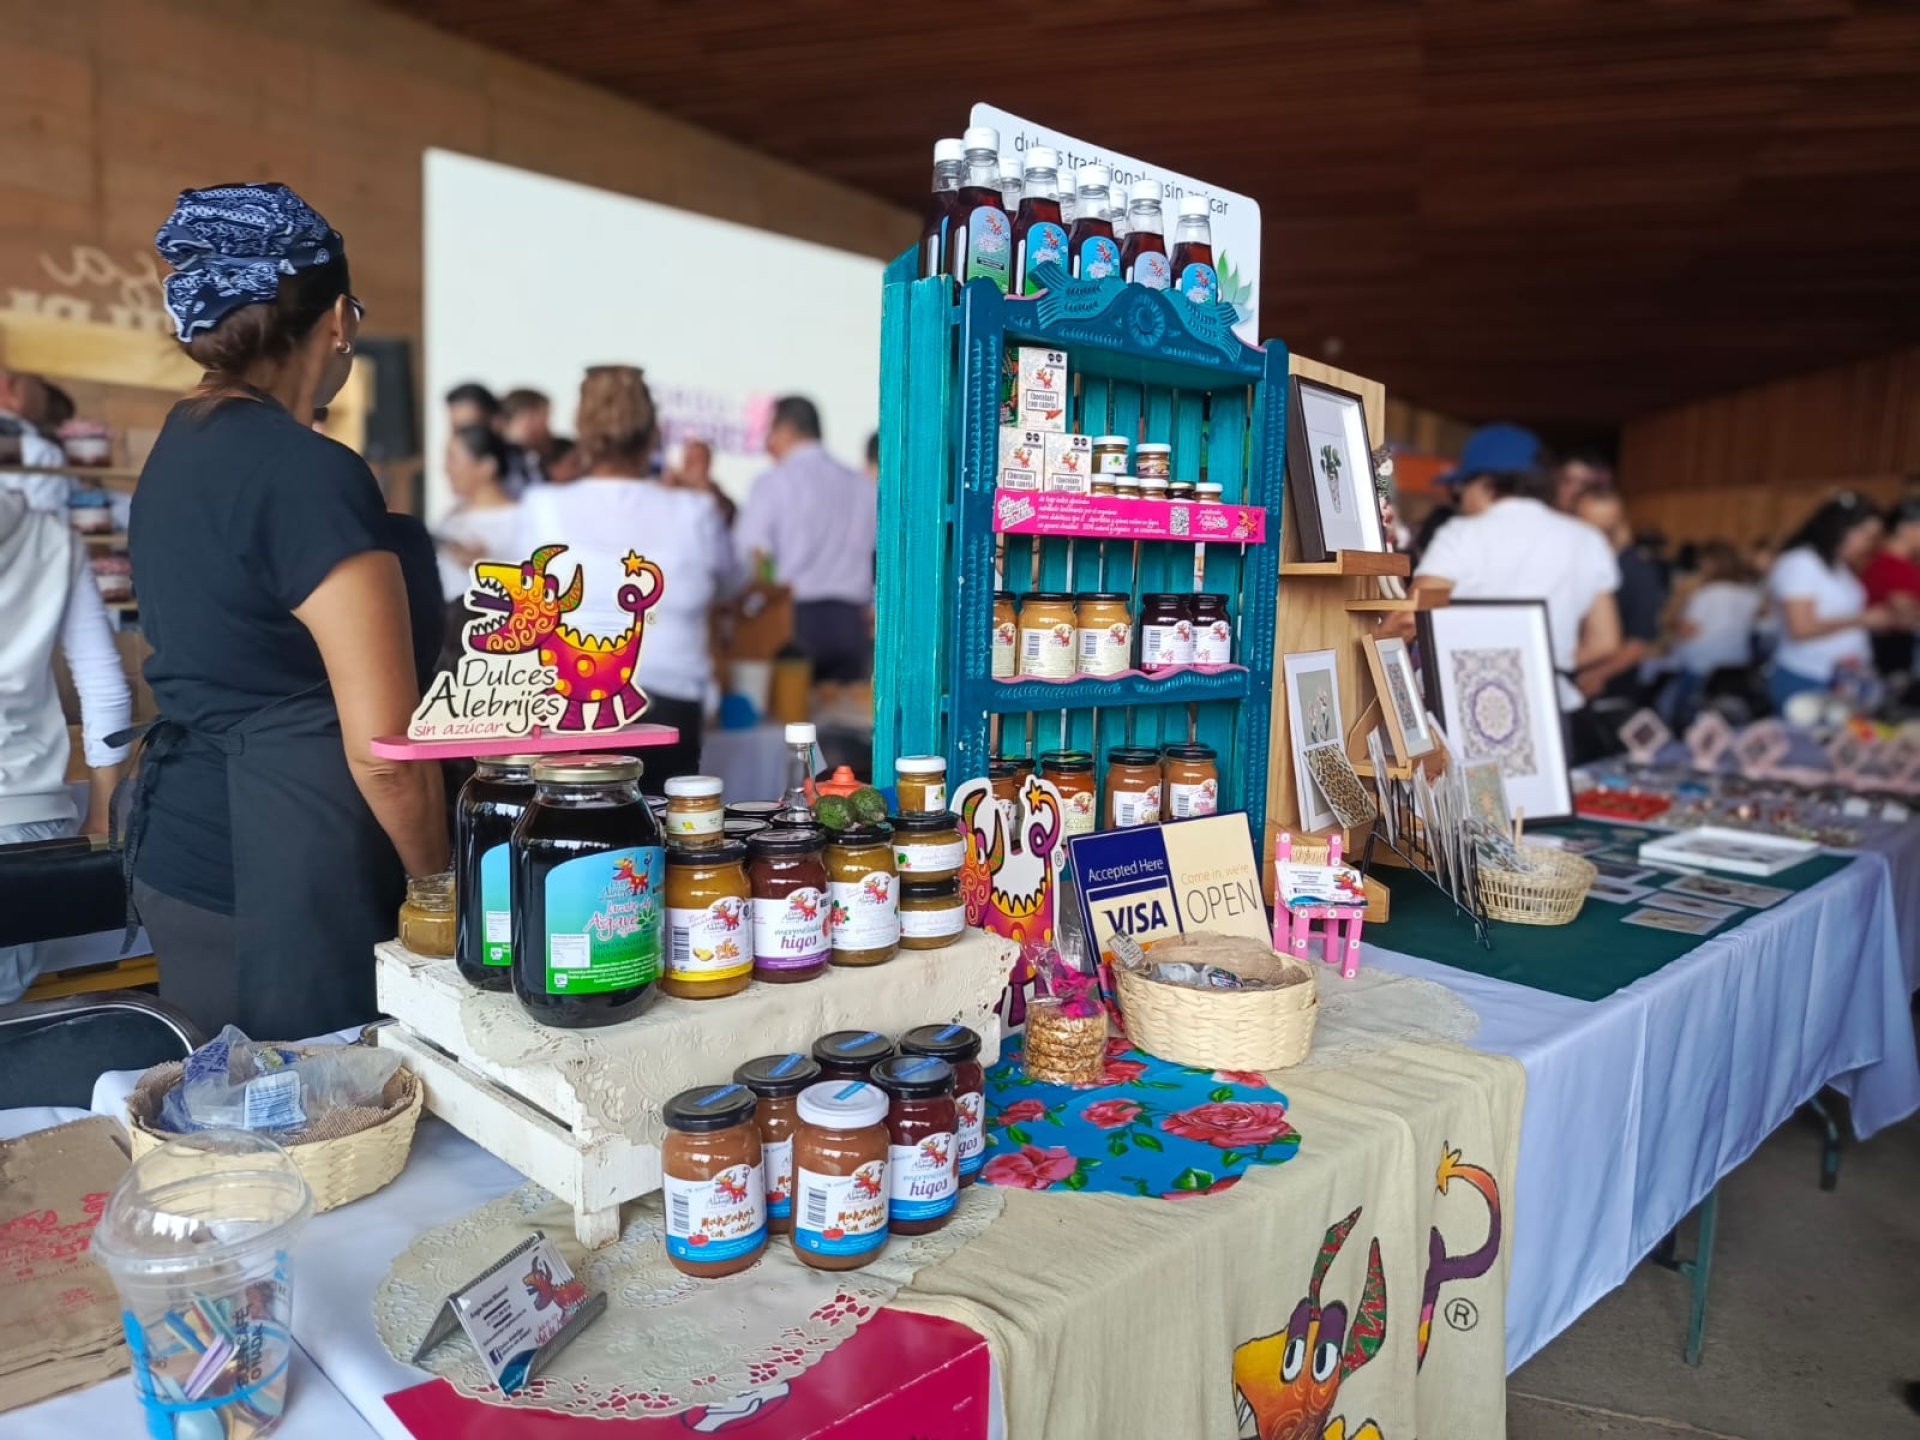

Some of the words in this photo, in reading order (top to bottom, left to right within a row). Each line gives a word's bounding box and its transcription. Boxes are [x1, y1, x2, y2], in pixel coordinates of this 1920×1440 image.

[463, 658, 556, 688] Dulces
[418, 676, 560, 734] Alebrijes
[413, 720, 436, 736] sin
[443, 719, 504, 736] azúcar
[1088, 864, 1138, 883] Accepted
[1139, 858, 1165, 873] Here
[1180, 871, 1210, 886] Come
[1226, 863, 1250, 879] we're
[1186, 878, 1259, 925] OPEN
[1101, 900, 1169, 936] VISA
[780, 935, 818, 953] higos
[909, 1179, 948, 1199] higos
